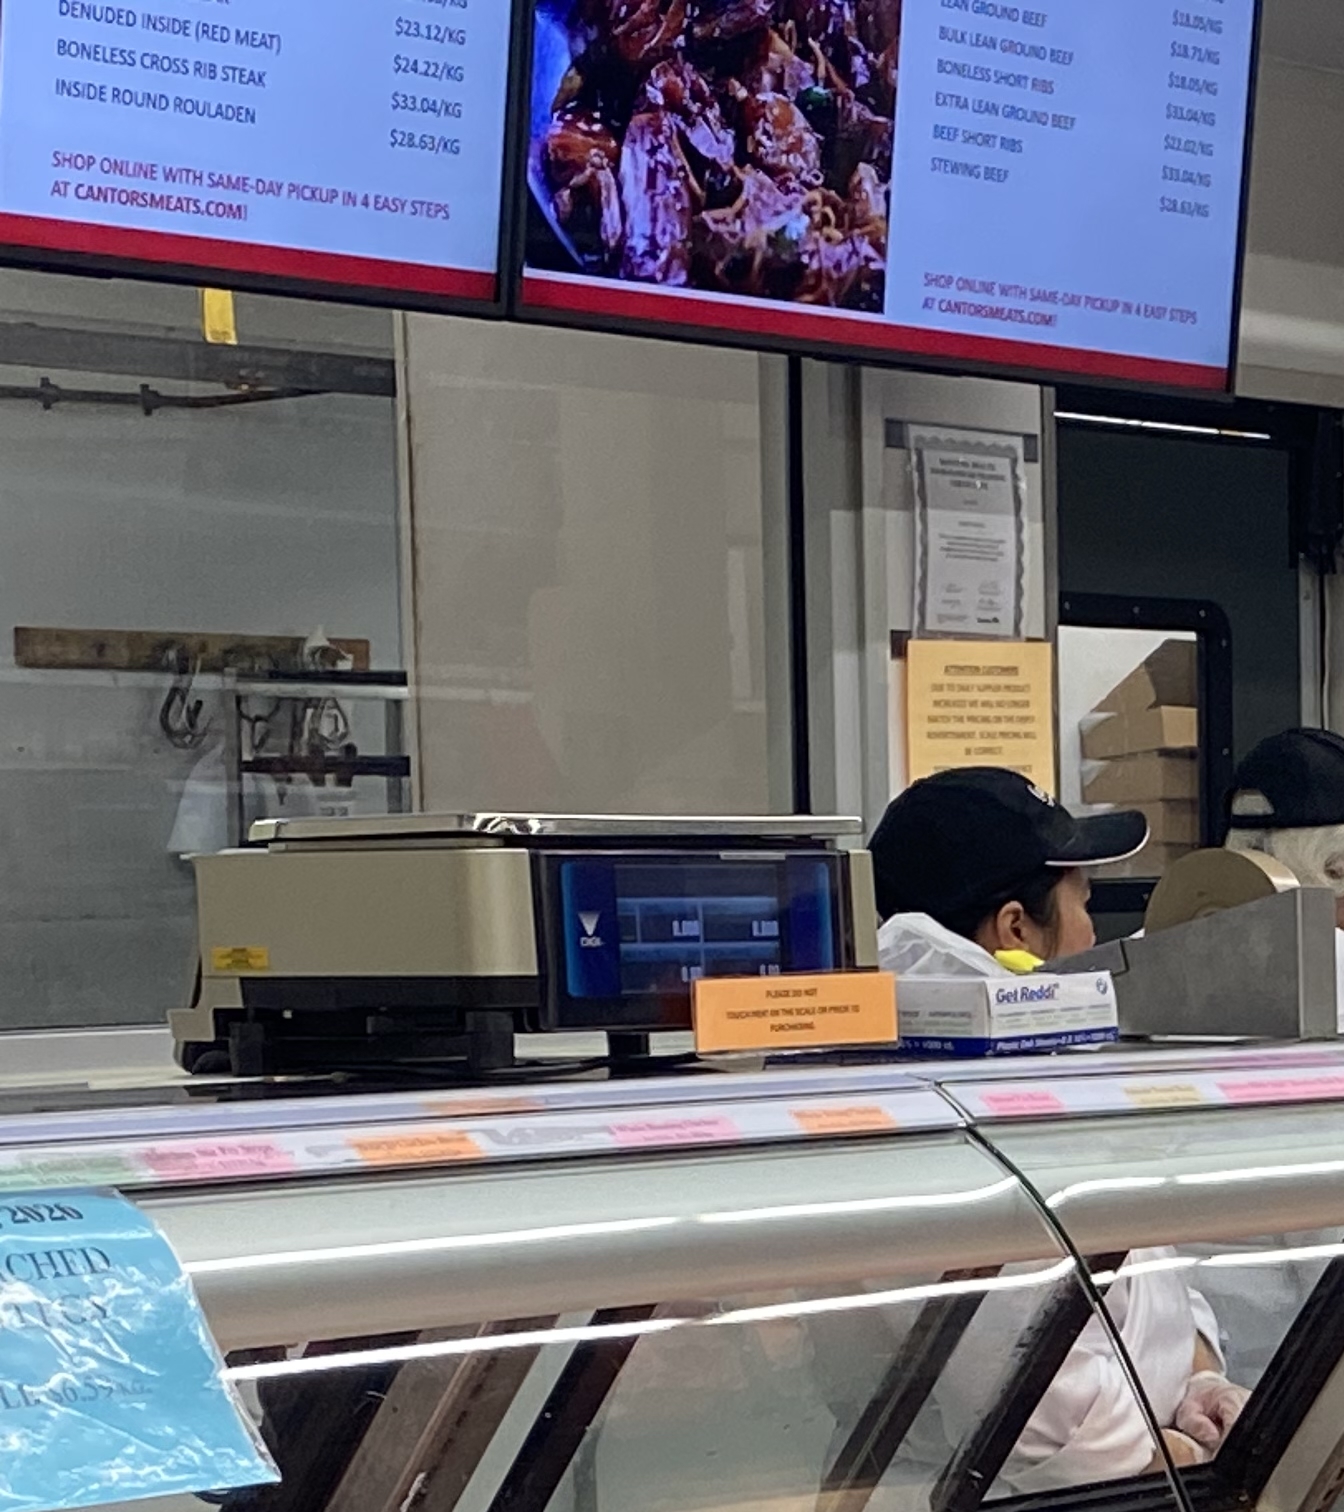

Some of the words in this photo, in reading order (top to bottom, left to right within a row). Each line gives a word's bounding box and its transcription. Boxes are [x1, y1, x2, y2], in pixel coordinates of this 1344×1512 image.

[58, 0, 136, 27] DENUDED
[141, 13, 191, 37] INSIDE
[195, 20, 230, 43] (RED
[235, 29, 282, 55] MEAT)
[940, 0, 969, 13] LEAN
[971, 1, 1019, 22] GROUND
[1022, 10, 1048, 28] BEEF
[395, 16, 466, 46] $23.12/KG
[938, 25, 967, 44] BULK
[969, 32, 997, 50] LEAN
[1000, 38, 1047, 61] GROUND
[1049, 48, 1074, 66] BEEF
[57, 39, 136, 67] BONELESS
[140, 52, 189, 76] CROSS
[193, 61, 217, 80] RIB
[221, 65, 267, 88] STEAK
[393, 54, 464, 82] $24.22/KG
[937, 58, 992, 84] BONELESS
[993, 69, 1028, 89] SHORT
[1030, 77, 1054, 95] RIBS
[55, 78, 107, 102] INSIDE
[111, 87, 169, 112] ROUND
[174, 96, 256, 124] ROULADEN
[391, 91, 462, 119] $33.04/KG
[935, 91, 969, 111] EXTRA
[971, 99, 999, 117] LEAN
[1001, 104, 1049, 127] GROUND
[1051, 113, 1076, 131] BEEF
[390, 128, 460, 155] $28.63/KG
[932, 124, 959, 142] BEEF
[961, 129, 997, 148] SHORT
[1000, 136, 1023, 153] RIBS
[930, 157, 981, 180] STEWING
[983, 166, 1009, 183] BEEF
[51, 180, 71, 198] AT
[52, 150, 96, 172] SHOP
[100, 156, 157, 181] ONLINE
[162, 165, 203, 187] WITH
[207, 171, 284, 198] SAME-DAY
[287, 183, 339, 204] PICKUP
[343, 191, 357, 208] IN
[360, 194, 369, 210] 4
[374, 195, 407, 215] EASY
[411, 201, 450, 220] STEPS
[922, 297, 935, 310] AT
[923, 272, 954, 288] SHOP
[955, 276, 996, 297] ONLINE
[1000, 282, 1028, 300] WITH
[1030, 287, 1083, 308] SAME-DAY
[1084, 295, 1119, 313] PICKUP
[1122, 301, 1133, 315] IN
[1143, 302, 1167, 321] EASY
[1169, 307, 1198, 325] STEPS
[995, 987, 1018, 1004] Get
[10, 1202, 84, 1224] 2026
